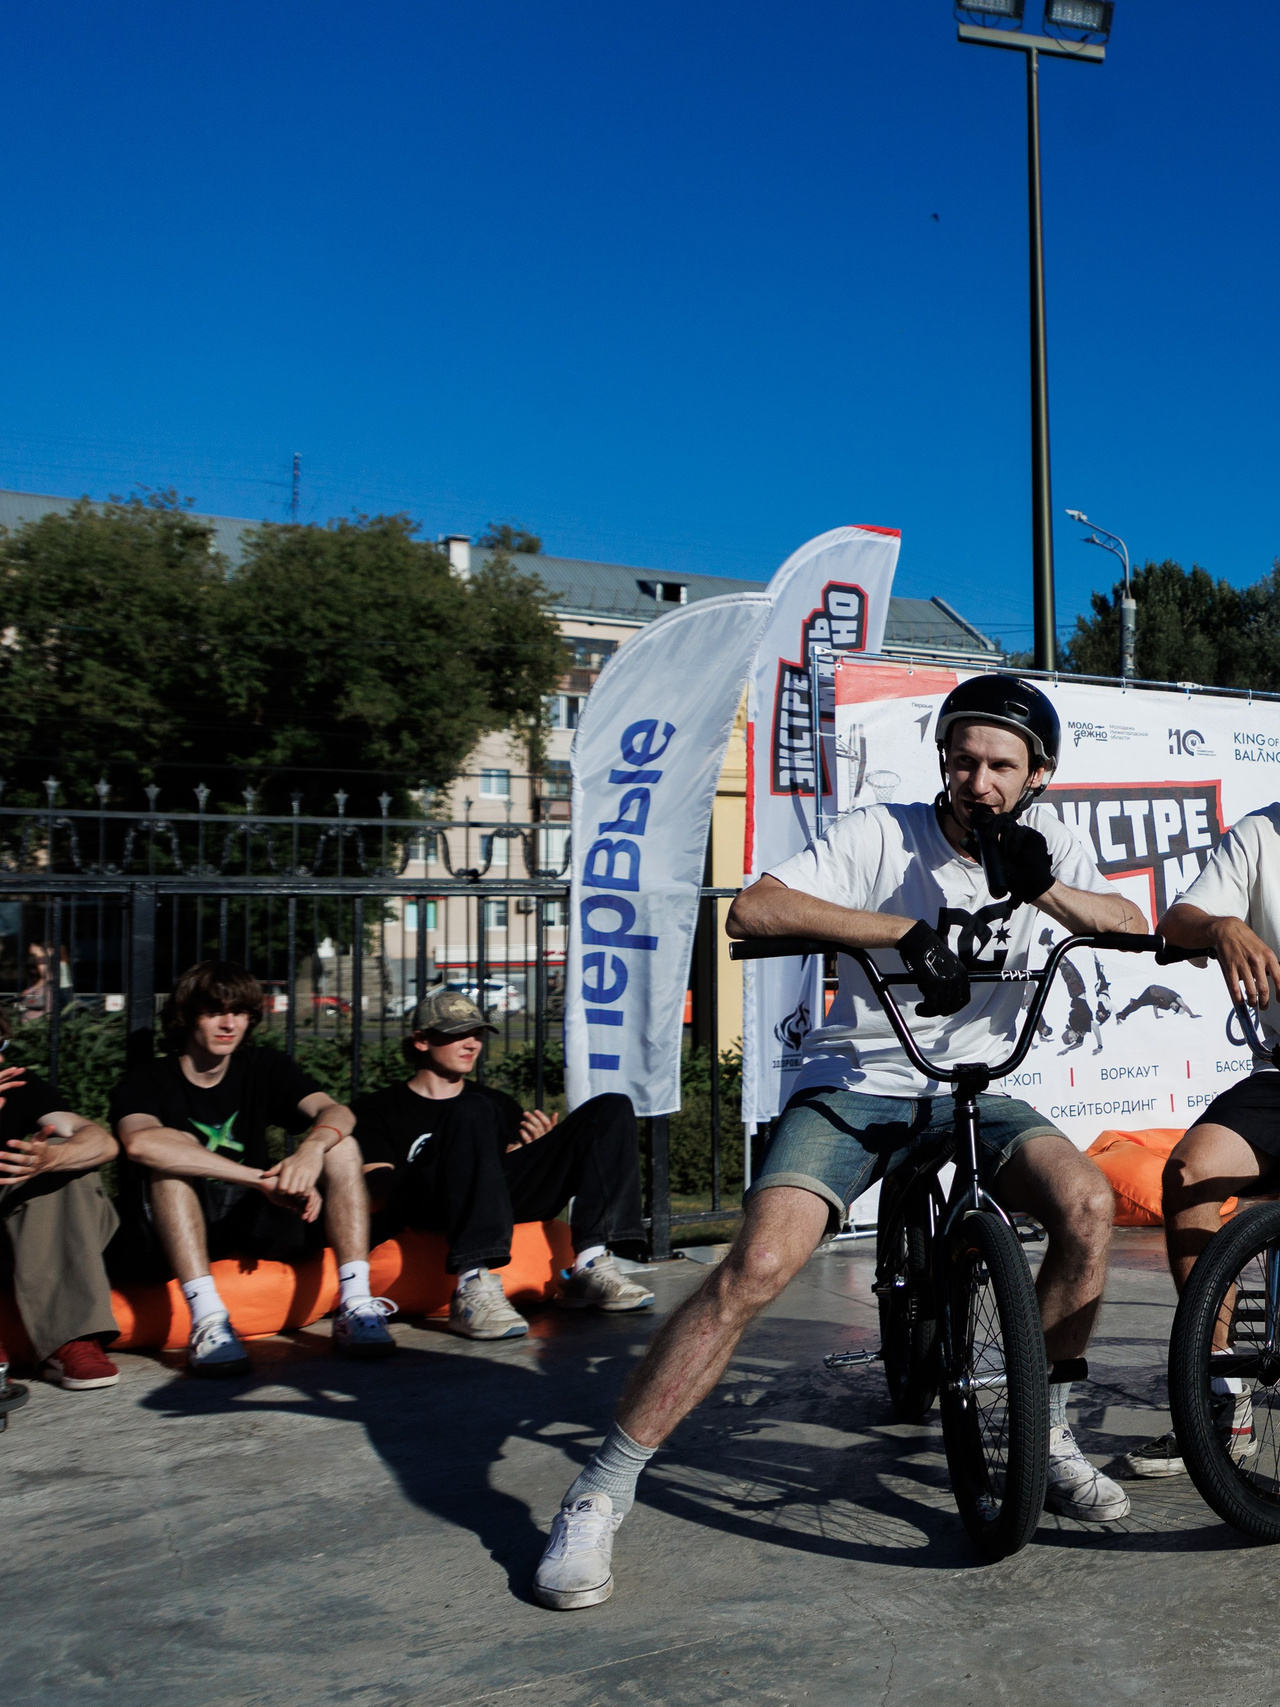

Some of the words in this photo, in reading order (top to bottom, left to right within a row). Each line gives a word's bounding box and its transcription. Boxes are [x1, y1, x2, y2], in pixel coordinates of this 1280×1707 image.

[828, 591, 860, 645] НО
[779, 671, 815, 787] ЭКСТРЕ
[1233, 731, 1266, 746] KING
[1267, 737, 1279, 747] OF
[1001, 970, 1032, 981] CULT
[1100, 1065, 1160, 1081] ВОРКАУТ
[1050, 1097, 1158, 1119] СКЕЙТБОРДИНГ
